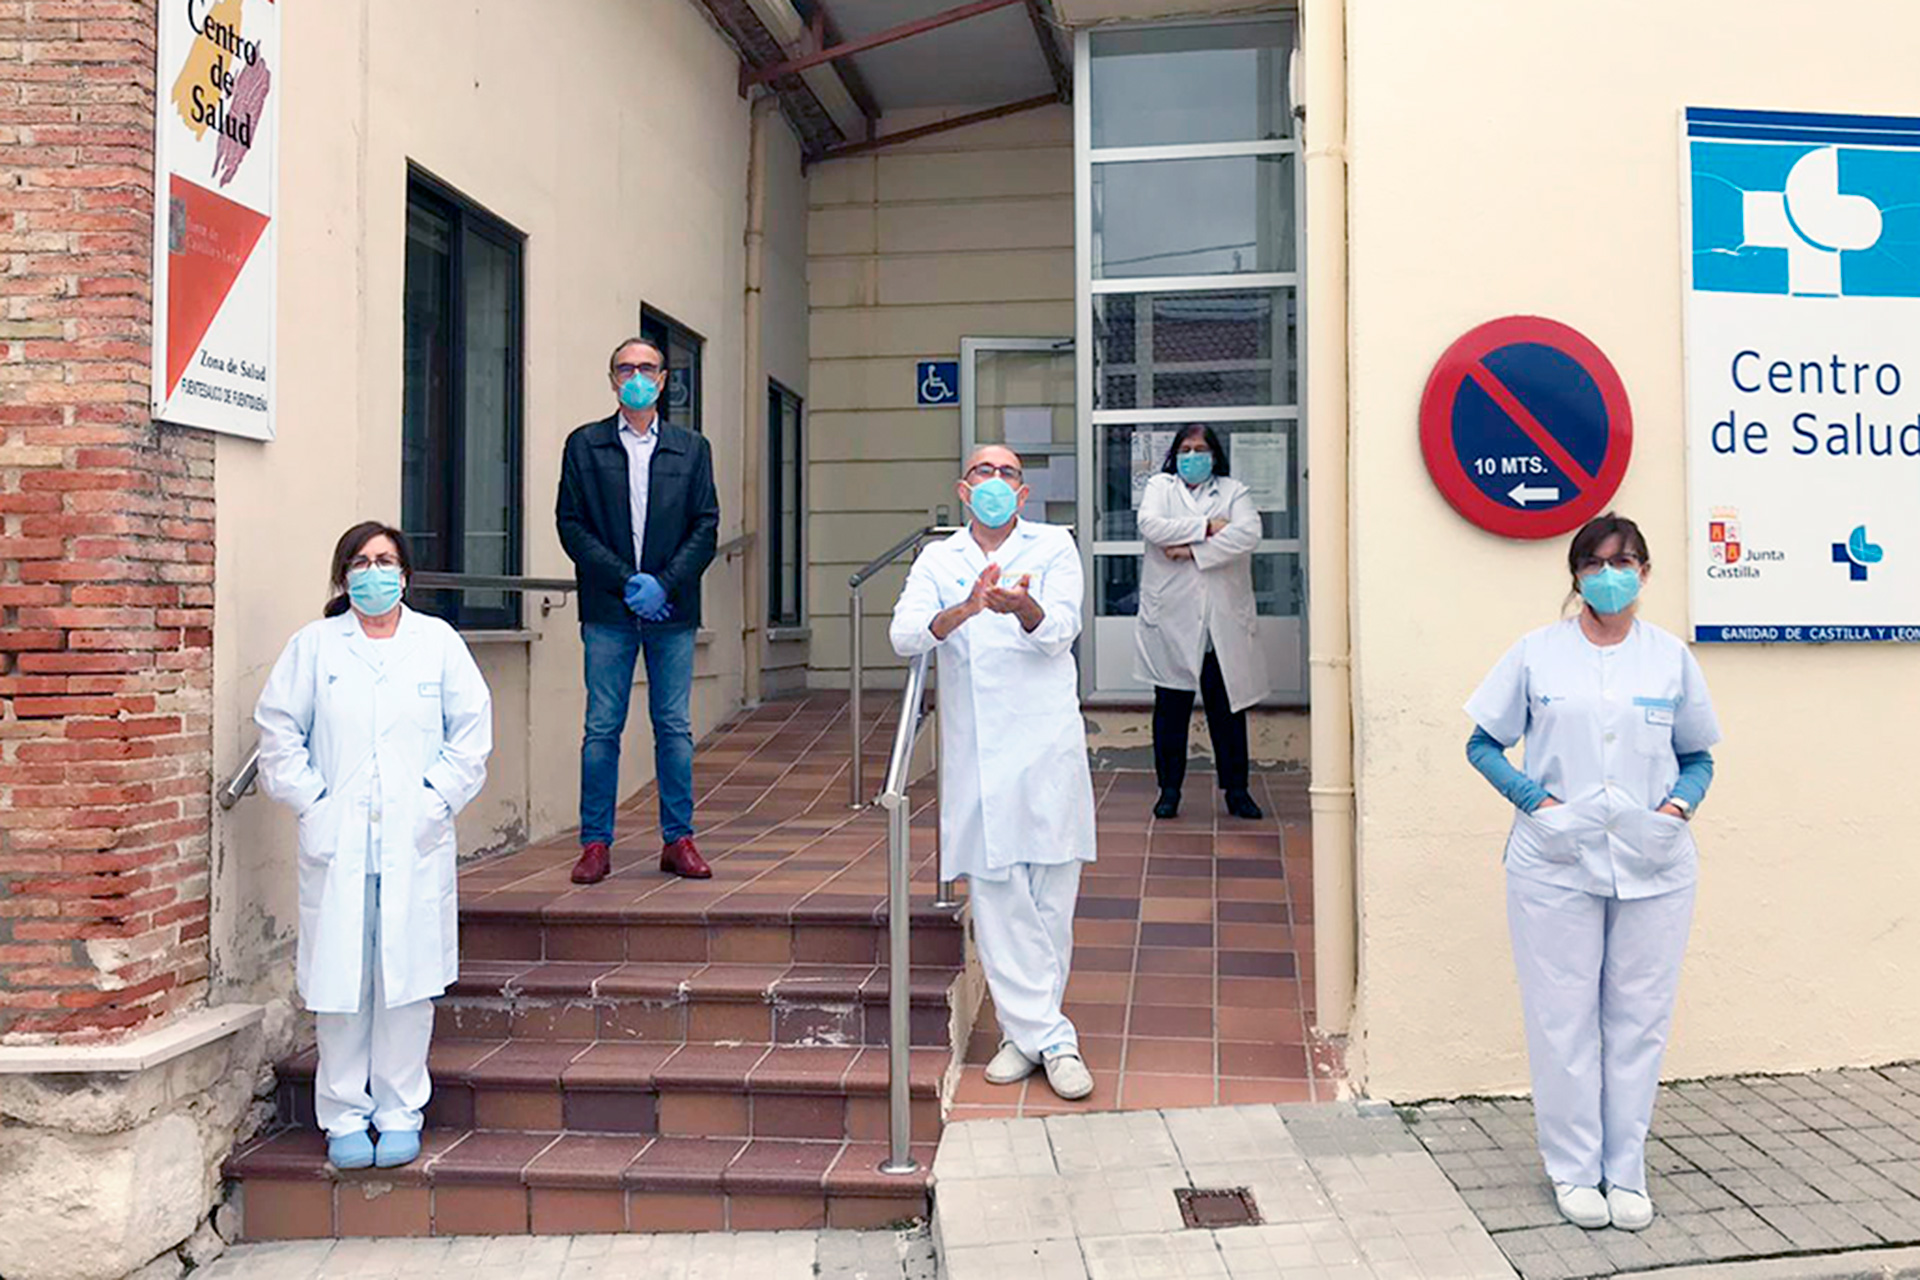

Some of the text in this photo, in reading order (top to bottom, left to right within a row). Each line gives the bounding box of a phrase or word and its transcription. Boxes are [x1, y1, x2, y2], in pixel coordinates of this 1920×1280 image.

[188, 0, 256, 66] Centro
[210, 55, 234, 99] de
[191, 85, 251, 149] Salud
[200, 348, 267, 382] Zona de Salud
[1731, 350, 1902, 395] Centro
[1711, 410, 1920, 457] de Salud
[1474, 456, 1549, 475] 10 MTS.
[1707, 565, 1761, 579] Castilla
[1745, 549, 1785, 562] Junta
[1785, 628, 1803, 640] DE
[1809, 627, 1871, 640] CASTILLA
[1876, 628, 1886, 640] Y
